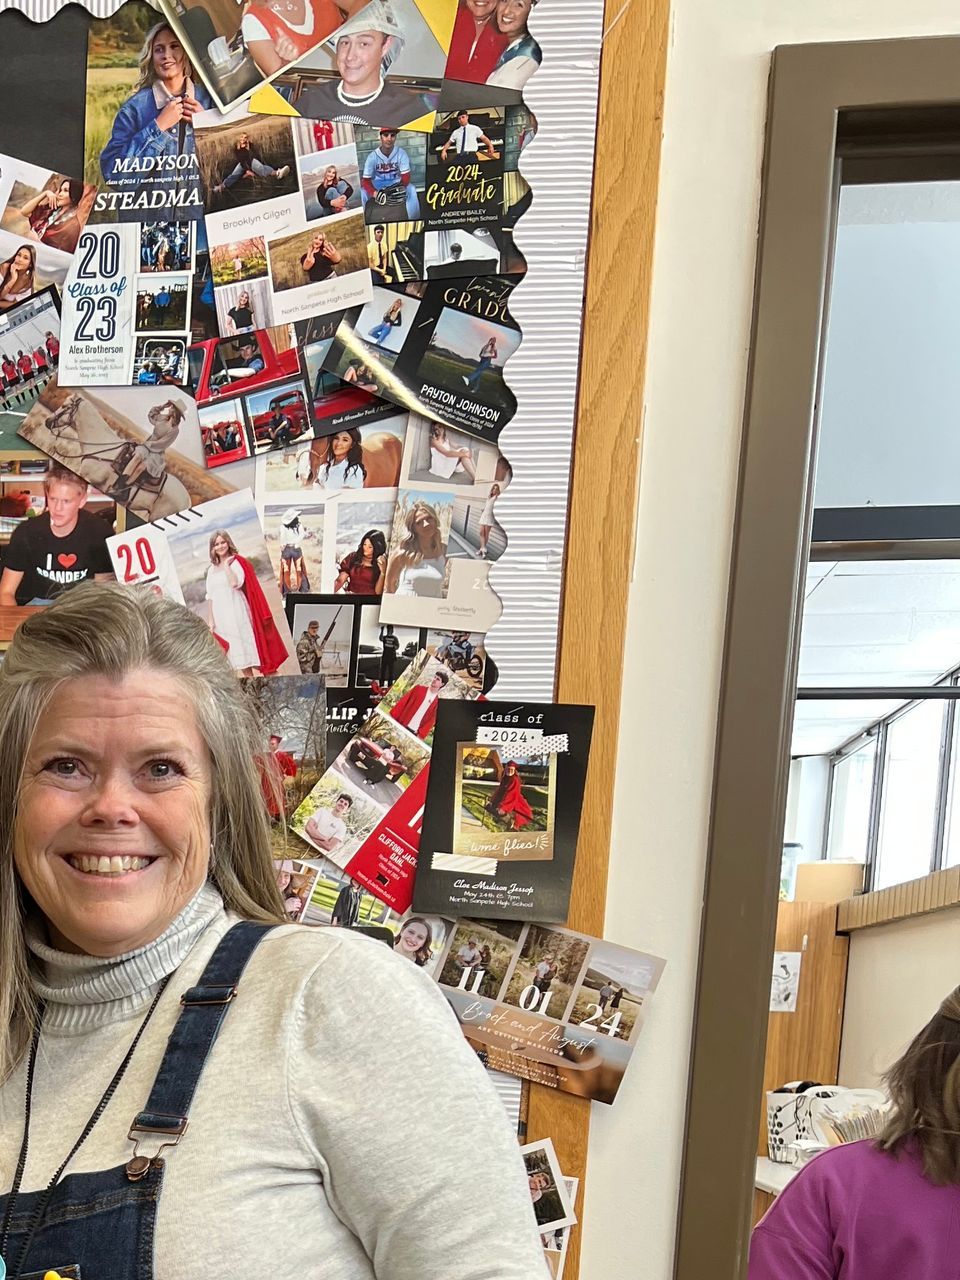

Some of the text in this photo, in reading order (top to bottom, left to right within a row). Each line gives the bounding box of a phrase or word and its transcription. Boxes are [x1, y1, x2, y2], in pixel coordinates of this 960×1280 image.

[446, 164, 483, 183] 2024
[94, 187, 204, 212] STEADMA
[426, 178, 497, 210] Graduate
[223, 207, 291, 230] Brooklyn Gilgen
[441, 208, 486, 218] ANDREW BAILEY
[480, 214, 498, 222] School
[77, 231, 121, 280] 20
[67, 277, 127, 298] Class of
[281, 304, 301, 315] North
[326, 293, 343, 308] High
[343, 288, 365, 302] School
[443, 287, 510, 323] GRADU
[74, 296, 117, 342] 23
[69, 345, 124, 354] Alex Brotherson
[420, 383, 456, 406] PAYTON
[456, 398, 500, 422] JOHNSON
[46, 554, 53, 570] I
[117, 537, 157, 583] 20
[479, 711, 544, 724] class of
[491, 731, 528, 743] 2024
[378, 833, 404, 855] CLIFFORD
[389, 852, 405, 867] DAHL
[454, 879, 534, 896] Cloe Madison Jessop
[464, 890, 477, 900] May
[449, 896, 468, 904] North
[469, 897, 495, 907] Sanpete
[497, 899, 510, 908] High
[455, 966, 624, 1037] 11 01 24
[461, 1001, 598, 1055] Brock and August
[477, 1025, 490, 1033] ARE
[493, 1031, 524, 1043] GETTING
